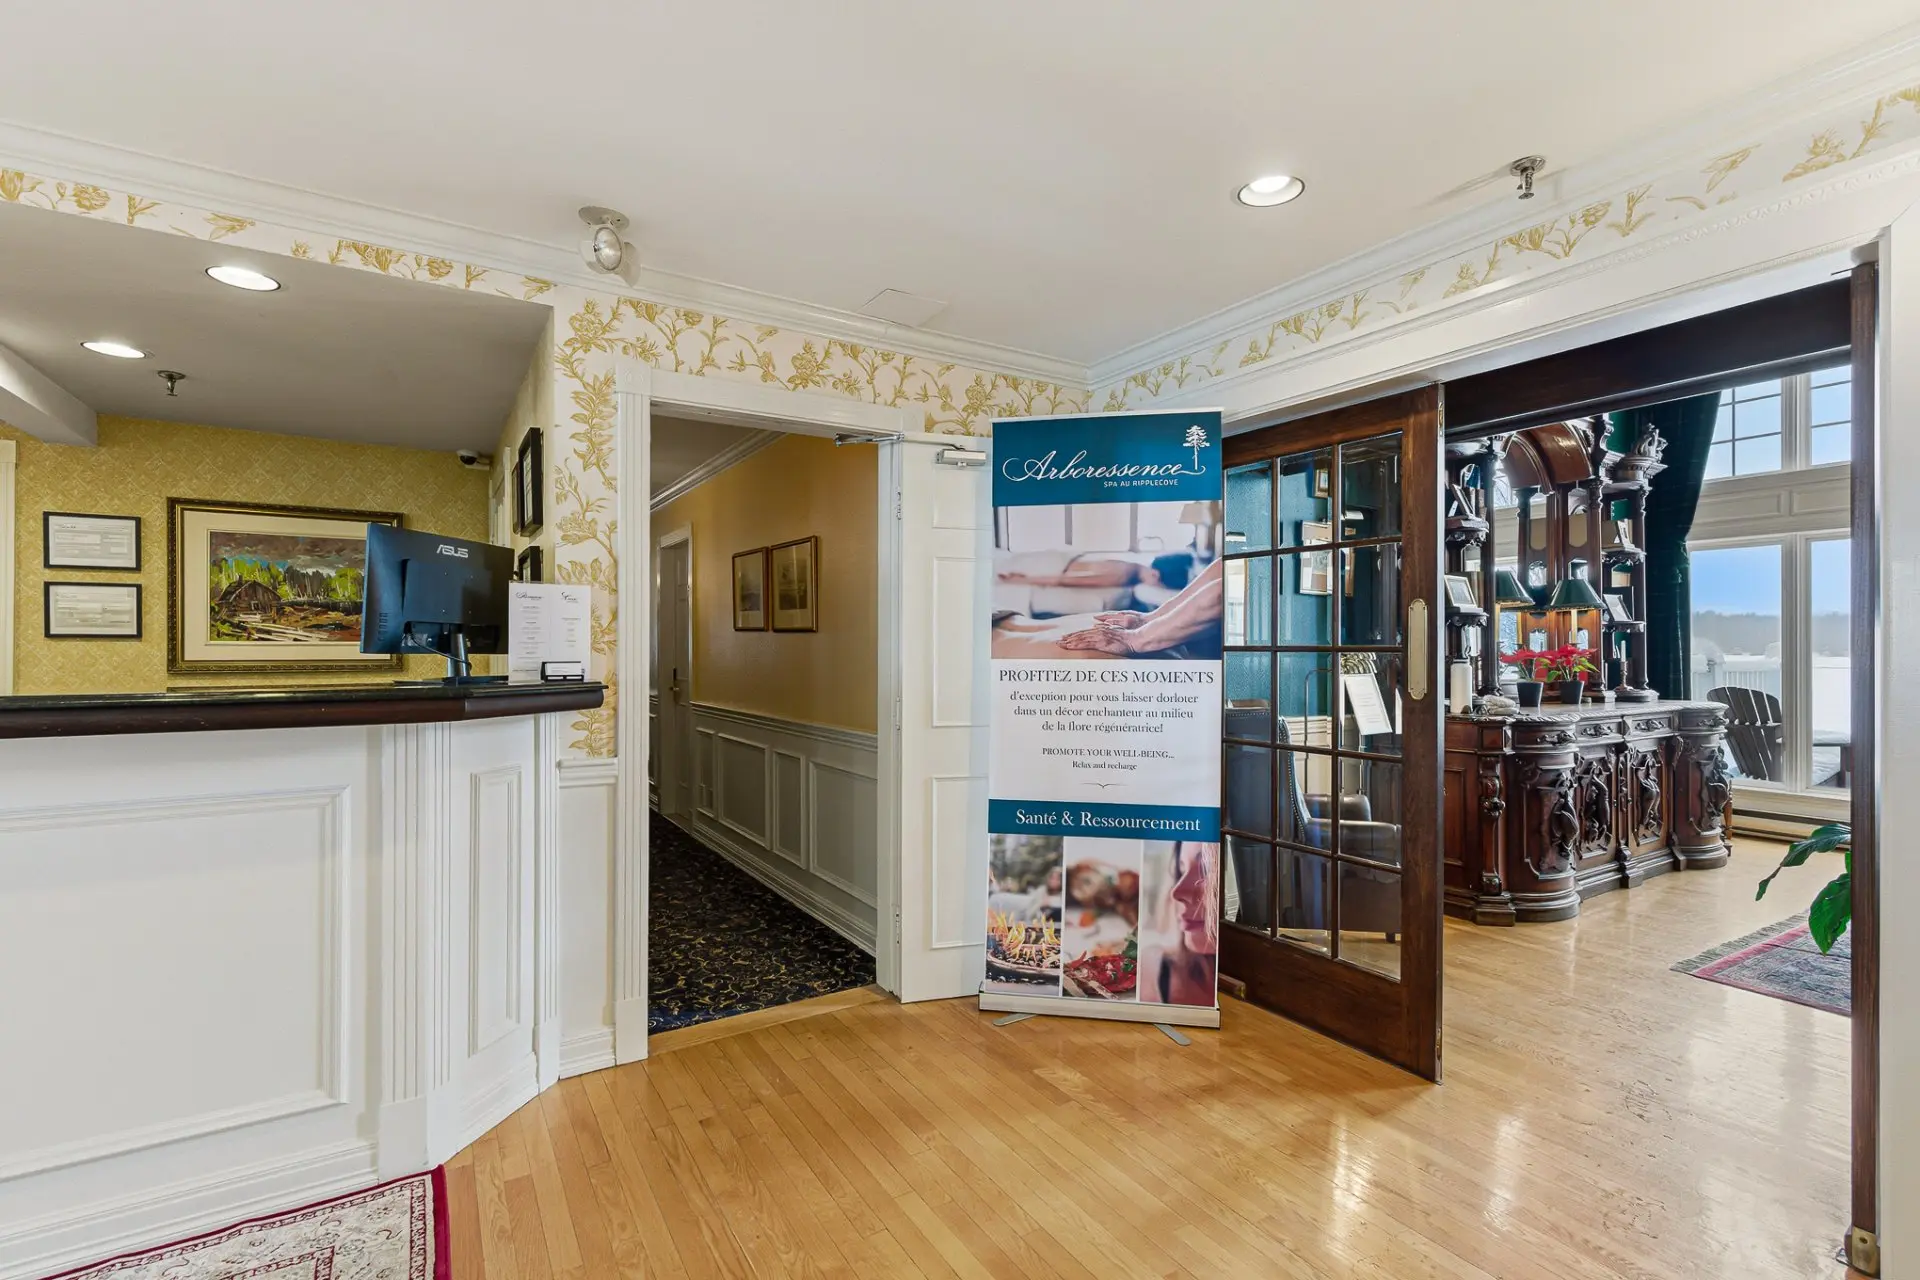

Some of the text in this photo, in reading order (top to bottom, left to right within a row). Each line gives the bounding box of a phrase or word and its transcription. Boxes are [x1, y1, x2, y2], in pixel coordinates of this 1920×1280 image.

[1002, 450, 1206, 481] Arboressence
[1132, 479, 1179, 487] RIPPLECOVE
[436, 544, 468, 558] ASUS
[999, 669, 1214, 684] PROFITEZ DE CES MOMENTS
[1010, 691, 1199, 704] d'exception pour vous laisser dorloter
[1013, 706, 1193, 719] dans un décor enchanteur au milieu
[1041, 721, 1164, 733] de la flore régénératrice!
[1042, 747, 1084, 756] PROMOTE
[1086, 748, 1112, 757] YOUR
[1072, 760, 1137, 770] Relax and recharge
[1016, 809, 1201, 831] Santé & Ressourcement
